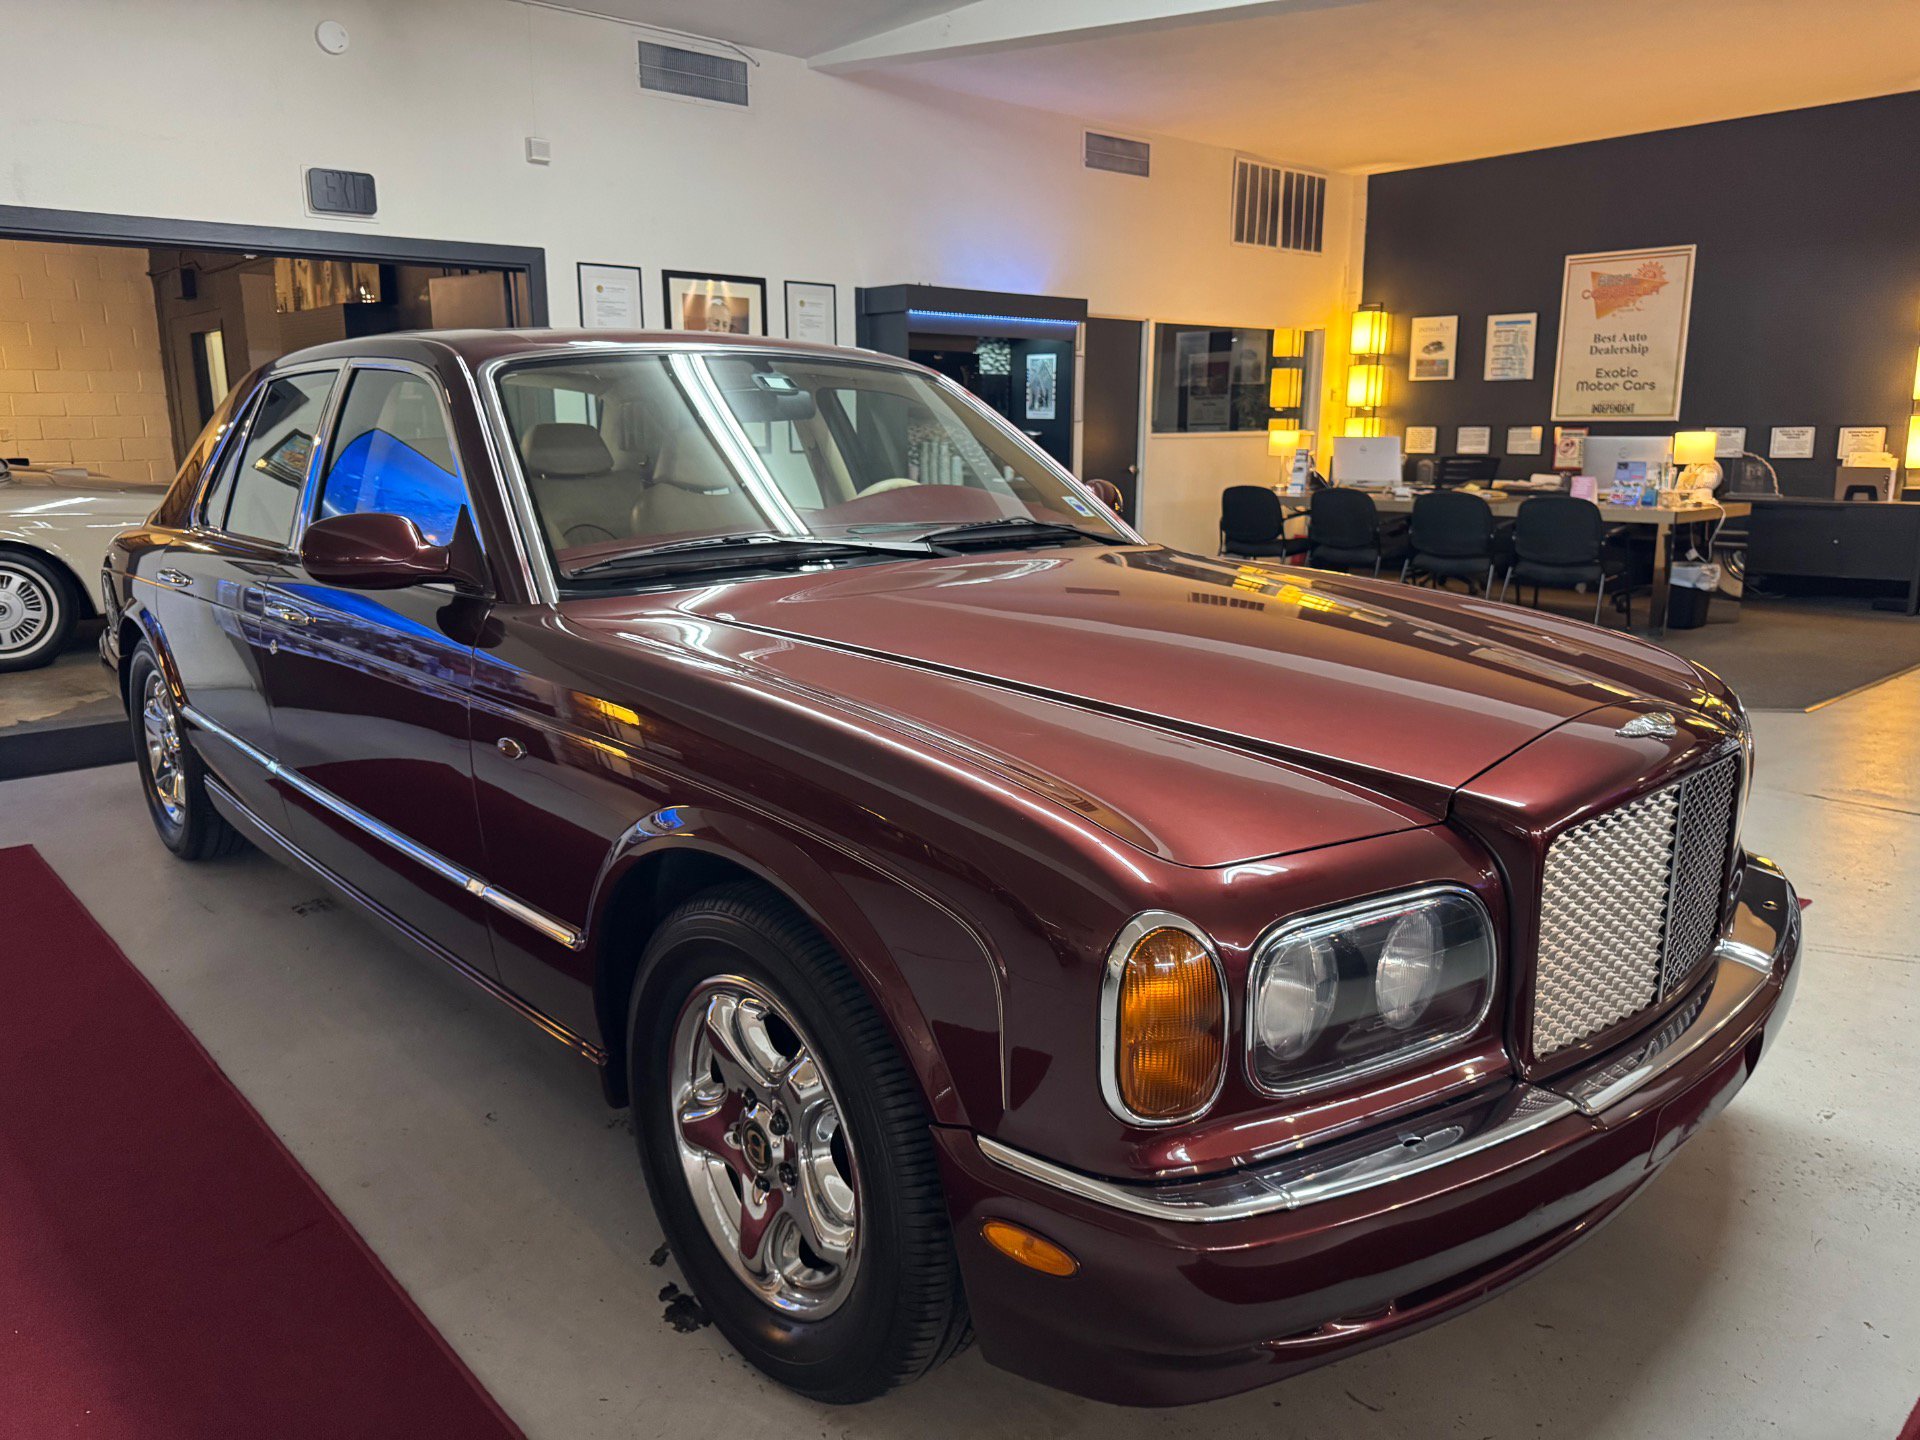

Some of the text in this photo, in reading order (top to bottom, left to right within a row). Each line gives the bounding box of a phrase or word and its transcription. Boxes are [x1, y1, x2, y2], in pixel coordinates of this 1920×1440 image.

[317, 171, 373, 210] EXIT
[1594, 333, 1647, 343] Best Auto
[1589, 343, 1649, 356] Dealership
[1595, 366, 1639, 378] Exotic
[1576, 380, 1656, 392] Motor Cars
[1591, 403, 1635, 413] INDEPENDENT
